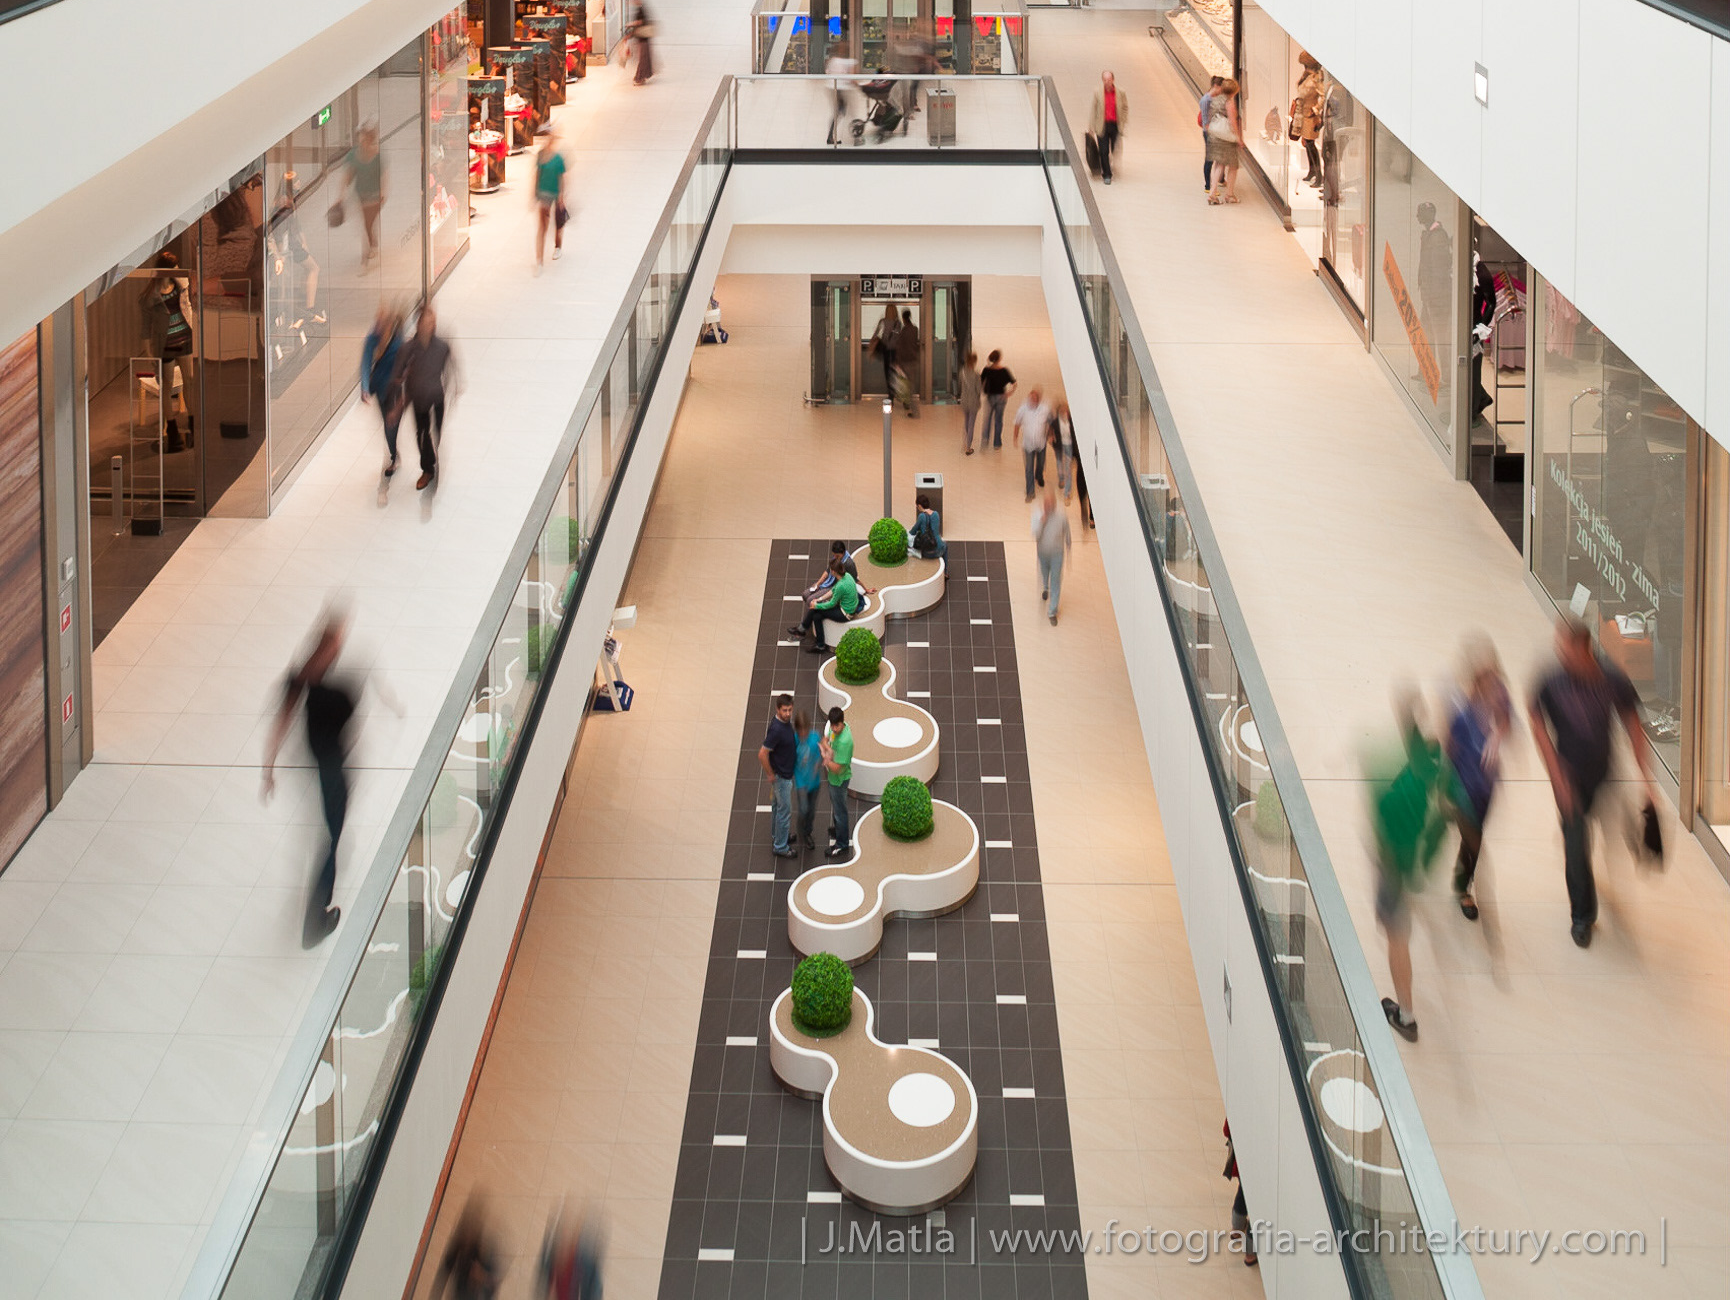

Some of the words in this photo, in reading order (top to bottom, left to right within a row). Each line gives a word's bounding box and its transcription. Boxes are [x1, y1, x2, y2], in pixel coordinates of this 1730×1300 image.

[529, 19, 560, 31] Douglas
[492, 53, 526, 67] Douglas
[1550, 457, 1589, 522] Kolekcja
[1590, 508, 1623, 564] jesień
[1631, 561, 1660, 611] zima
[1576, 521, 1626, 603] 2011/2012
